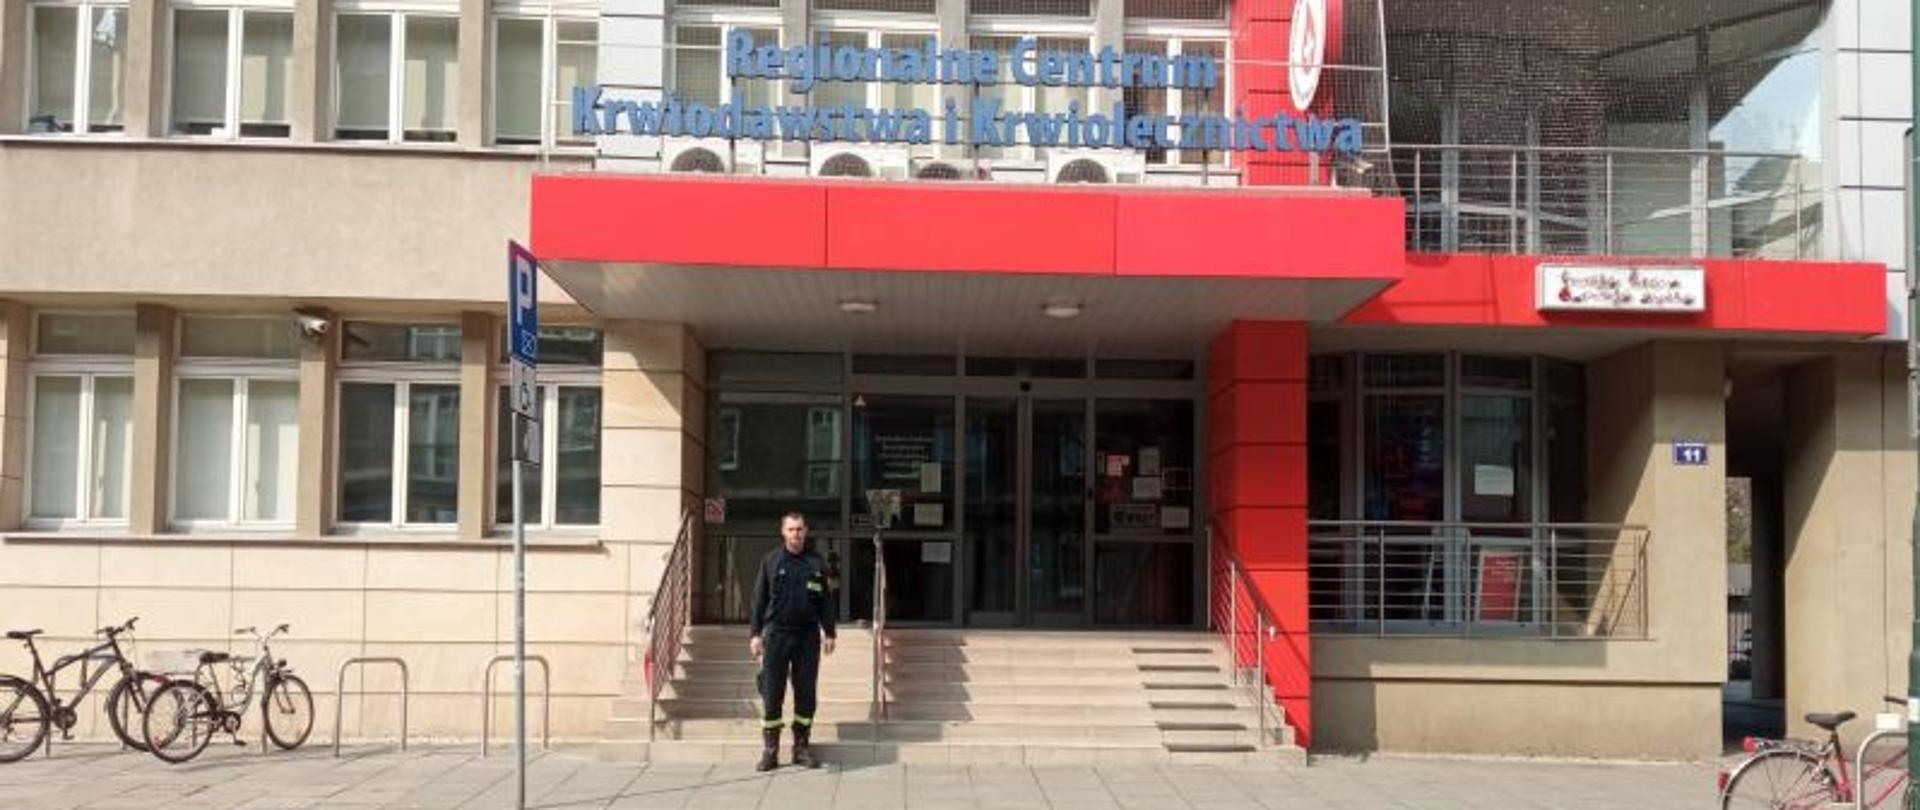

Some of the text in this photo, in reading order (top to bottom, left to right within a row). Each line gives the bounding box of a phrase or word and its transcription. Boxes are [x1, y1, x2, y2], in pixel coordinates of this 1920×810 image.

[727, 27, 1217, 94] Regionalne Centrum
[572, 84, 1364, 155] Krwiodawstwa i Krwiolecznictwa
[516, 254, 533, 326] P
[1684, 449, 1700, 462] 11
